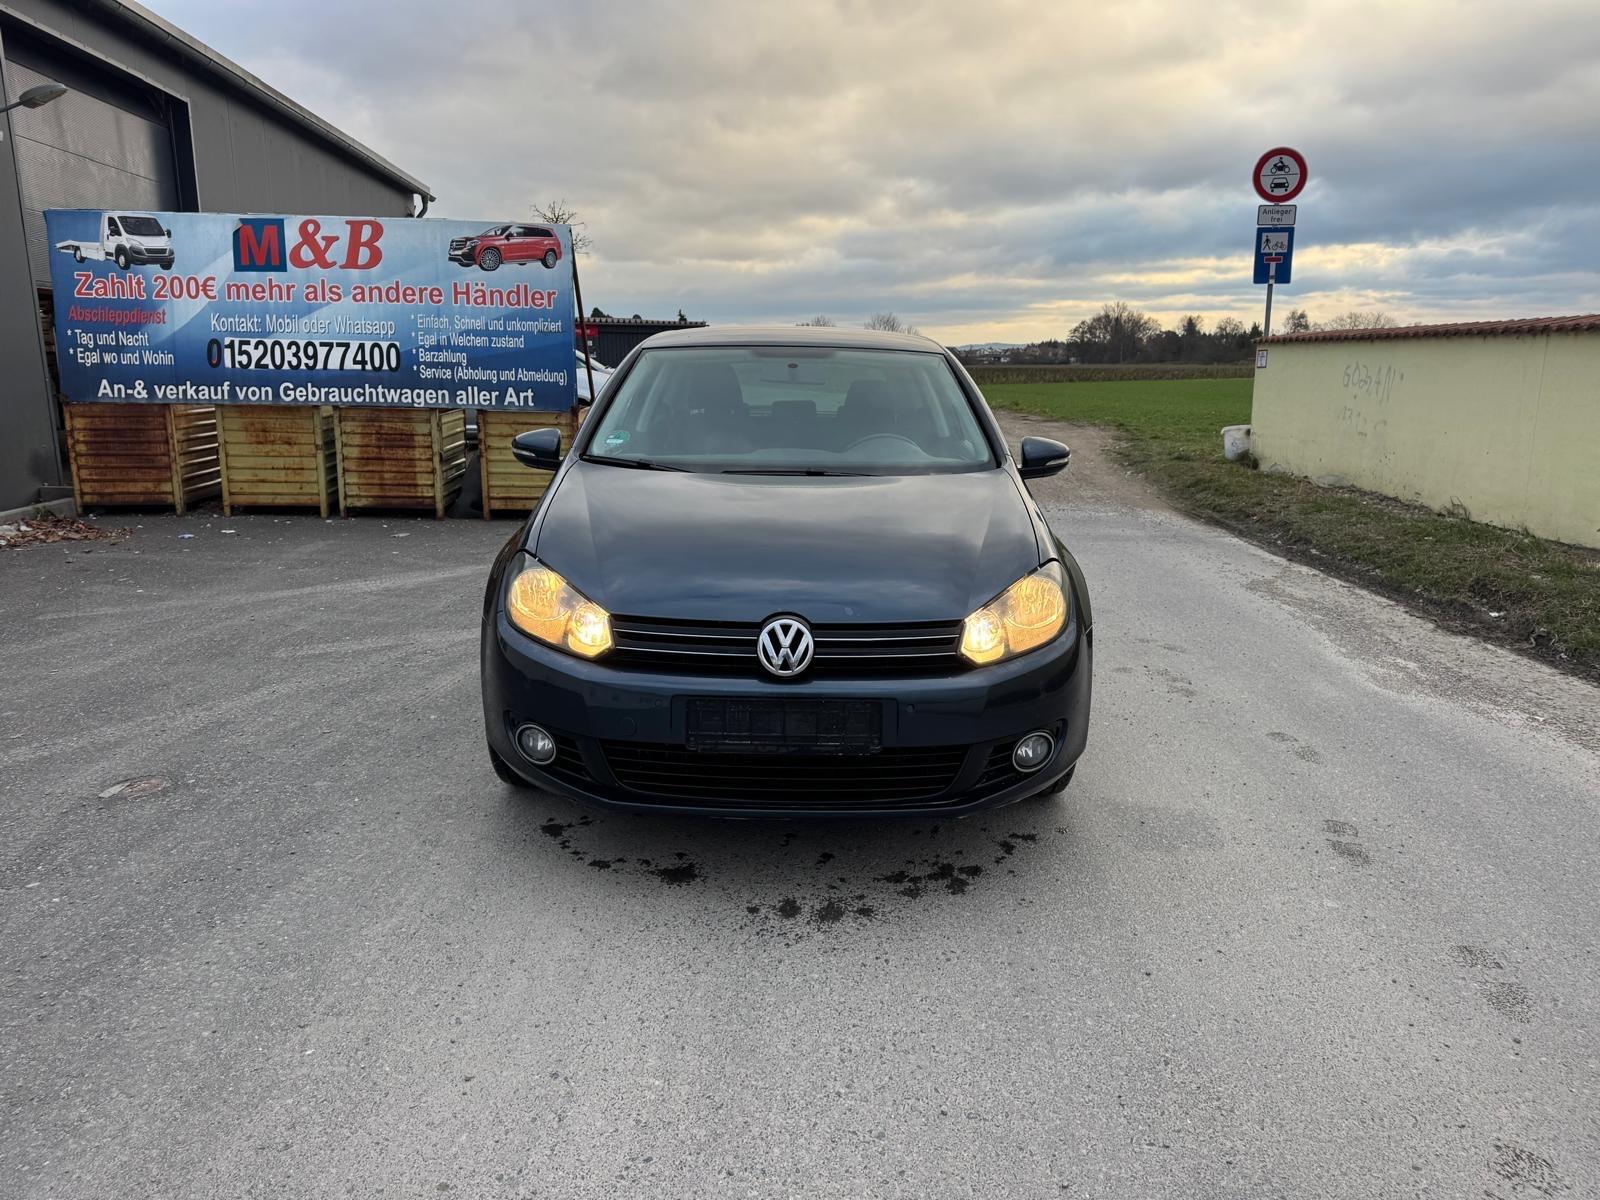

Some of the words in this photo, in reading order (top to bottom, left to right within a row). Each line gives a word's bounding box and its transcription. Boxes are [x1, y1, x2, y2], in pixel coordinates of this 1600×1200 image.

[1262, 208, 1292, 216] Anlieger
[1271, 215, 1283, 223] frei
[74, 272, 145, 299] Zahlt
[153, 275, 217, 300] 200€
[226, 278, 296, 301] mehr
[304, 279, 343, 304] als
[351, 280, 443, 304] andere
[452, 282, 557, 308] Händler
[68, 305, 167, 326] Abschleppdienst
[454, 315, 486, 330] Schnell
[488, 317, 504, 331] und
[506, 318, 562, 334] unkompliziert
[211, 313, 262, 333] Kontakt:
[266, 314, 299, 333] Mobil
[302, 315, 331, 334] oder
[334, 315, 396, 338] Whatsapp
[74, 329, 94, 348] Tag
[97, 331, 116, 345] und
[119, 331, 149, 347] Nacht
[418, 331, 437, 347] Egal
[440, 333, 448, 346] in
[450, 333, 489, 347] Welchem
[491, 335, 524, 348] zustand
[77, 348, 100, 367] Egal
[103, 352, 118, 364] wo
[121, 350, 140, 365] und
[142, 350, 175, 365] Wohin
[207, 338, 400, 372] 015203977400
[419, 349, 467, 366] Barzahlung
[419, 366, 452, 379] Service
[454, 366, 498, 383] (Abholung
[499, 368, 516, 381] und
[517, 368, 568, 386] Abmeldung)
[154, 381, 230, 400] verkauf
[235, 386, 273, 401] von
[279, 382, 449, 407] Gebrauchtwagen
[456, 386, 500, 406] aller
[503, 387, 534, 407] Art
